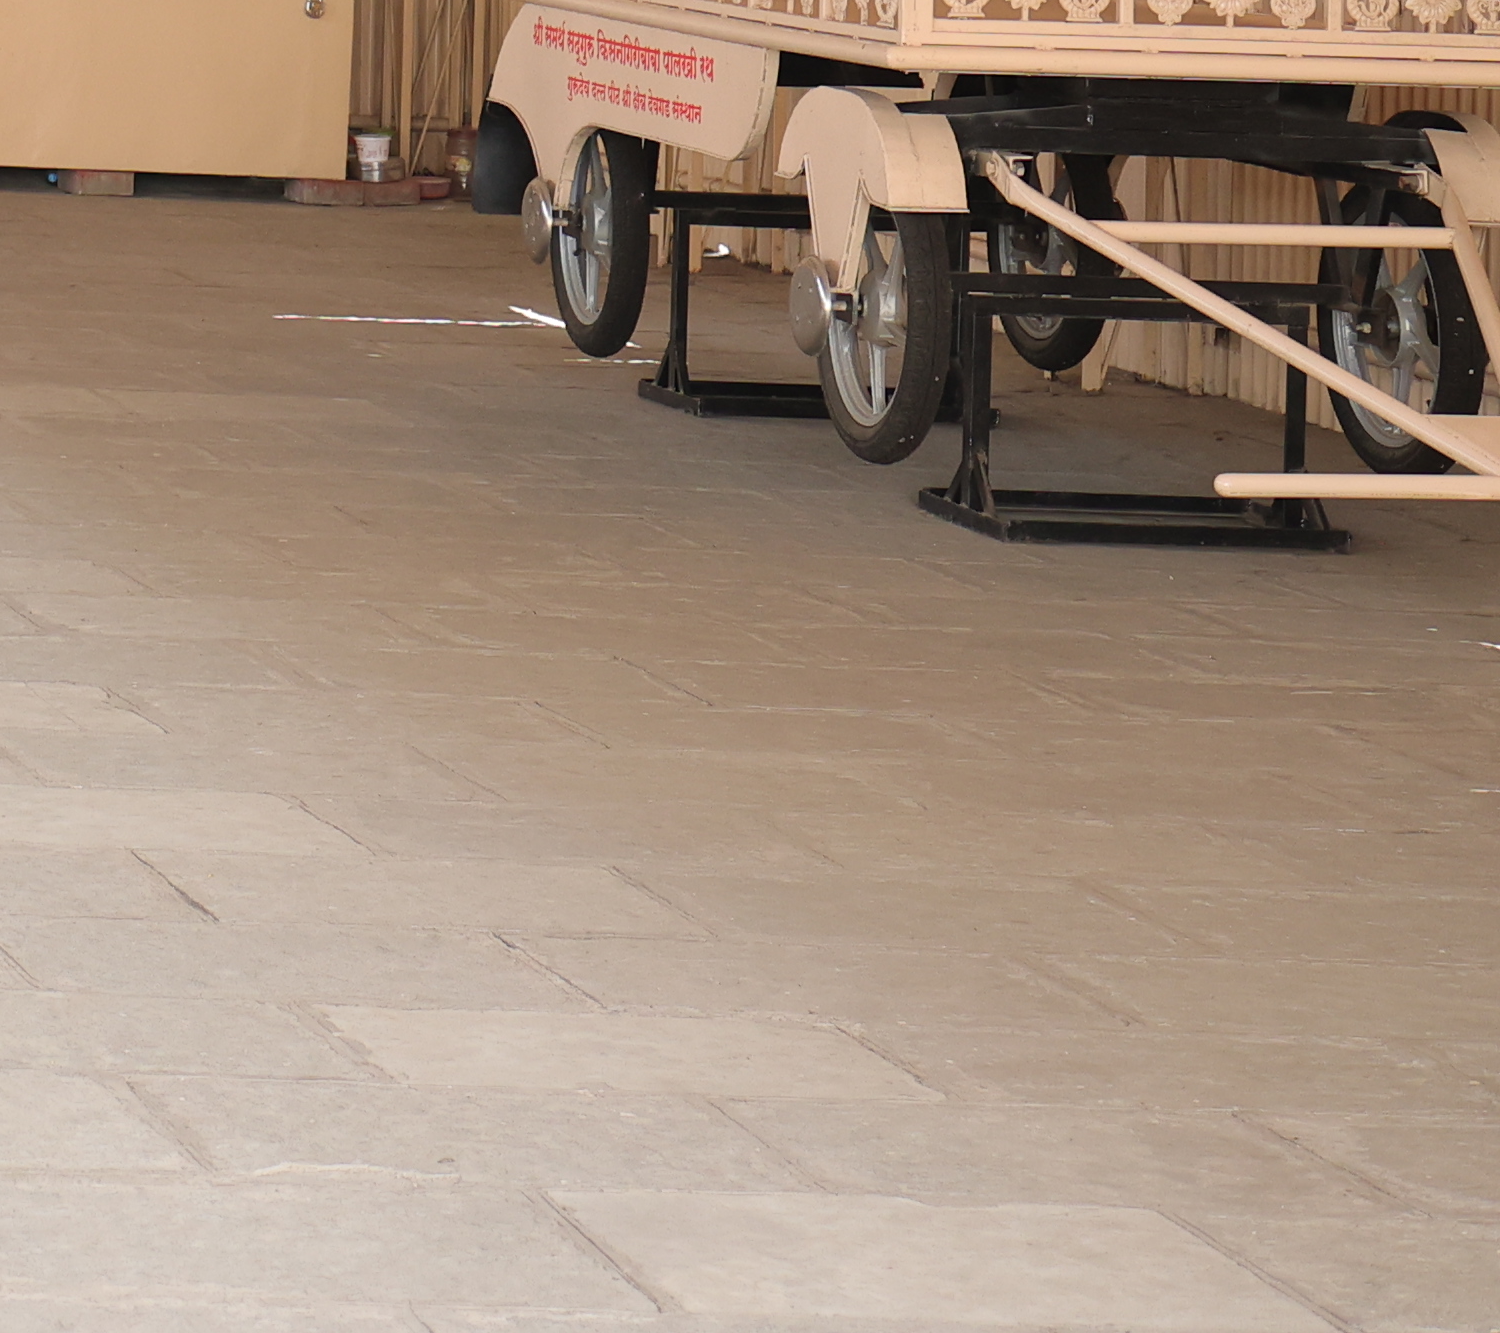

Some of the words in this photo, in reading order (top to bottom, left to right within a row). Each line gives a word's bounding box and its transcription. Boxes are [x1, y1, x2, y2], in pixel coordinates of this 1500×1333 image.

[533, 15, 543, 46] श्री
[545, 20, 566, 52] समर्थ
[662, 46, 697, 81] पालखी
[699, 54, 714, 83] रथ
[622, 83, 632, 109] श्री
[648, 88, 671, 119] देवगड
[672, 94, 702, 125] संस्थान
